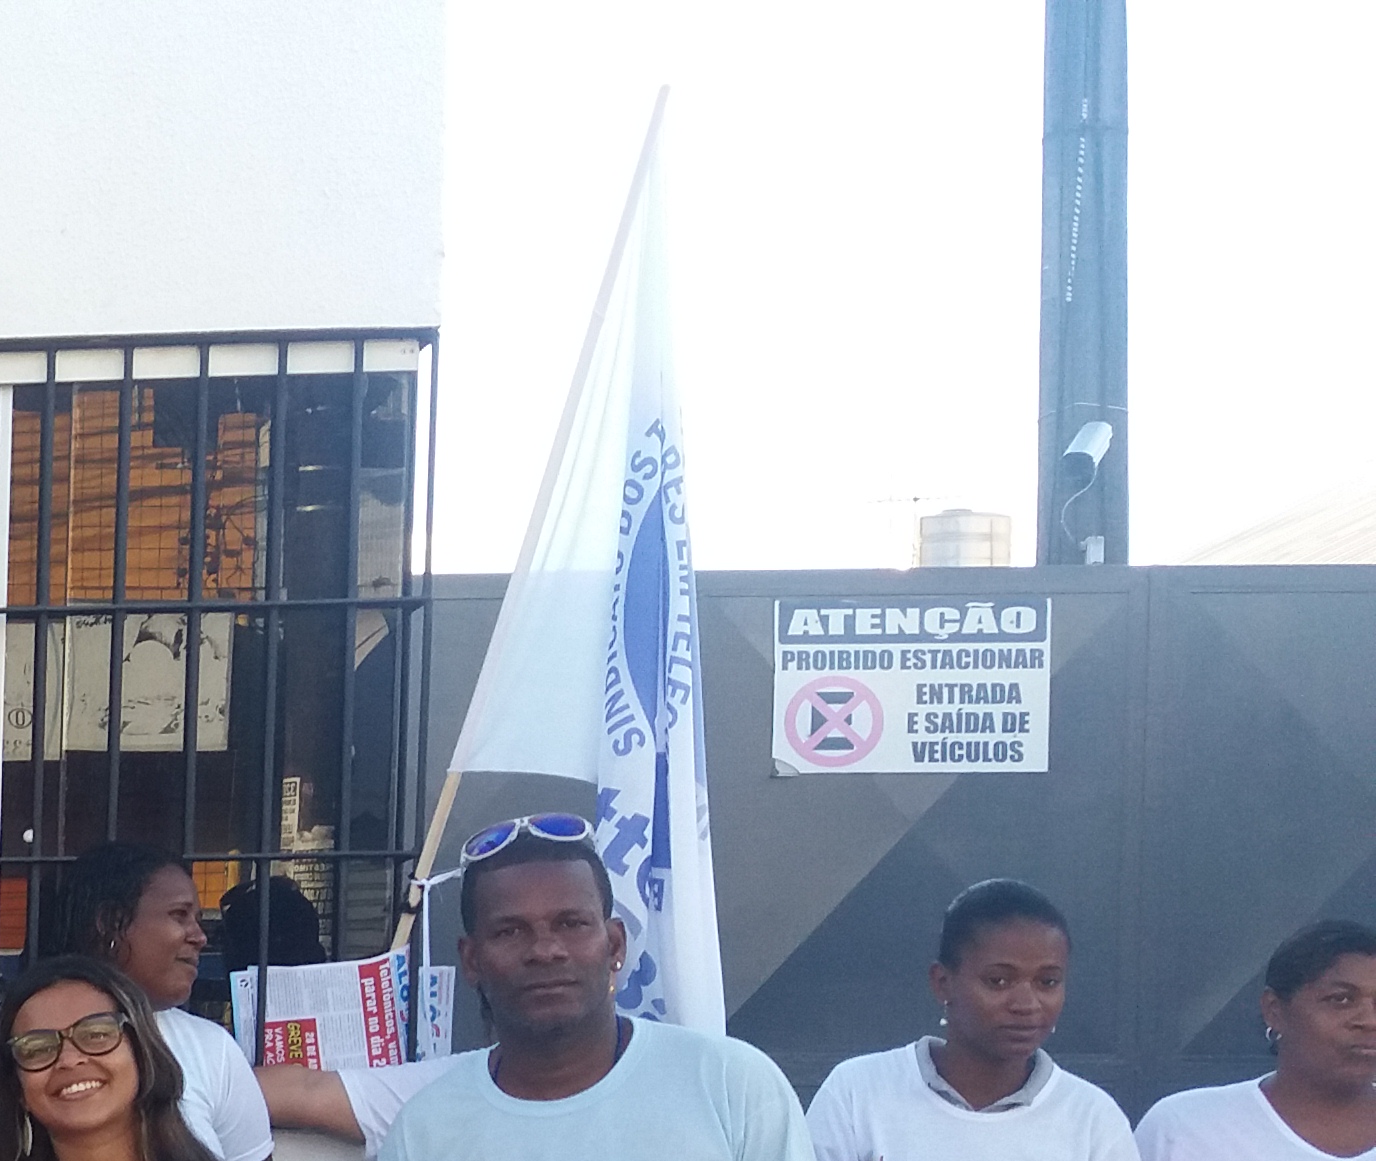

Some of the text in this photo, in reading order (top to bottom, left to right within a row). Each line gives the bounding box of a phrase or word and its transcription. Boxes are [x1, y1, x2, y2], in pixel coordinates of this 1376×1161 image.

[787, 602, 1037, 640] ATENÇÃO
[781, 648, 1045, 671] PROIBIDO ESTACIONAR
[915, 682, 1022, 705] ENTRADA
[907, 708, 1031, 734] E SAÍDA DE
[912, 738, 1025, 763] VEÍCULOS
[378, 961, 396, 1040] Telefônicos,
[360, 976, 387, 1068] parar no dia 2
[264, 1028, 275, 1065] PRA AC
[274, 1027, 285, 1063] VAMOS
[287, 1023, 303, 1059] GREVE
